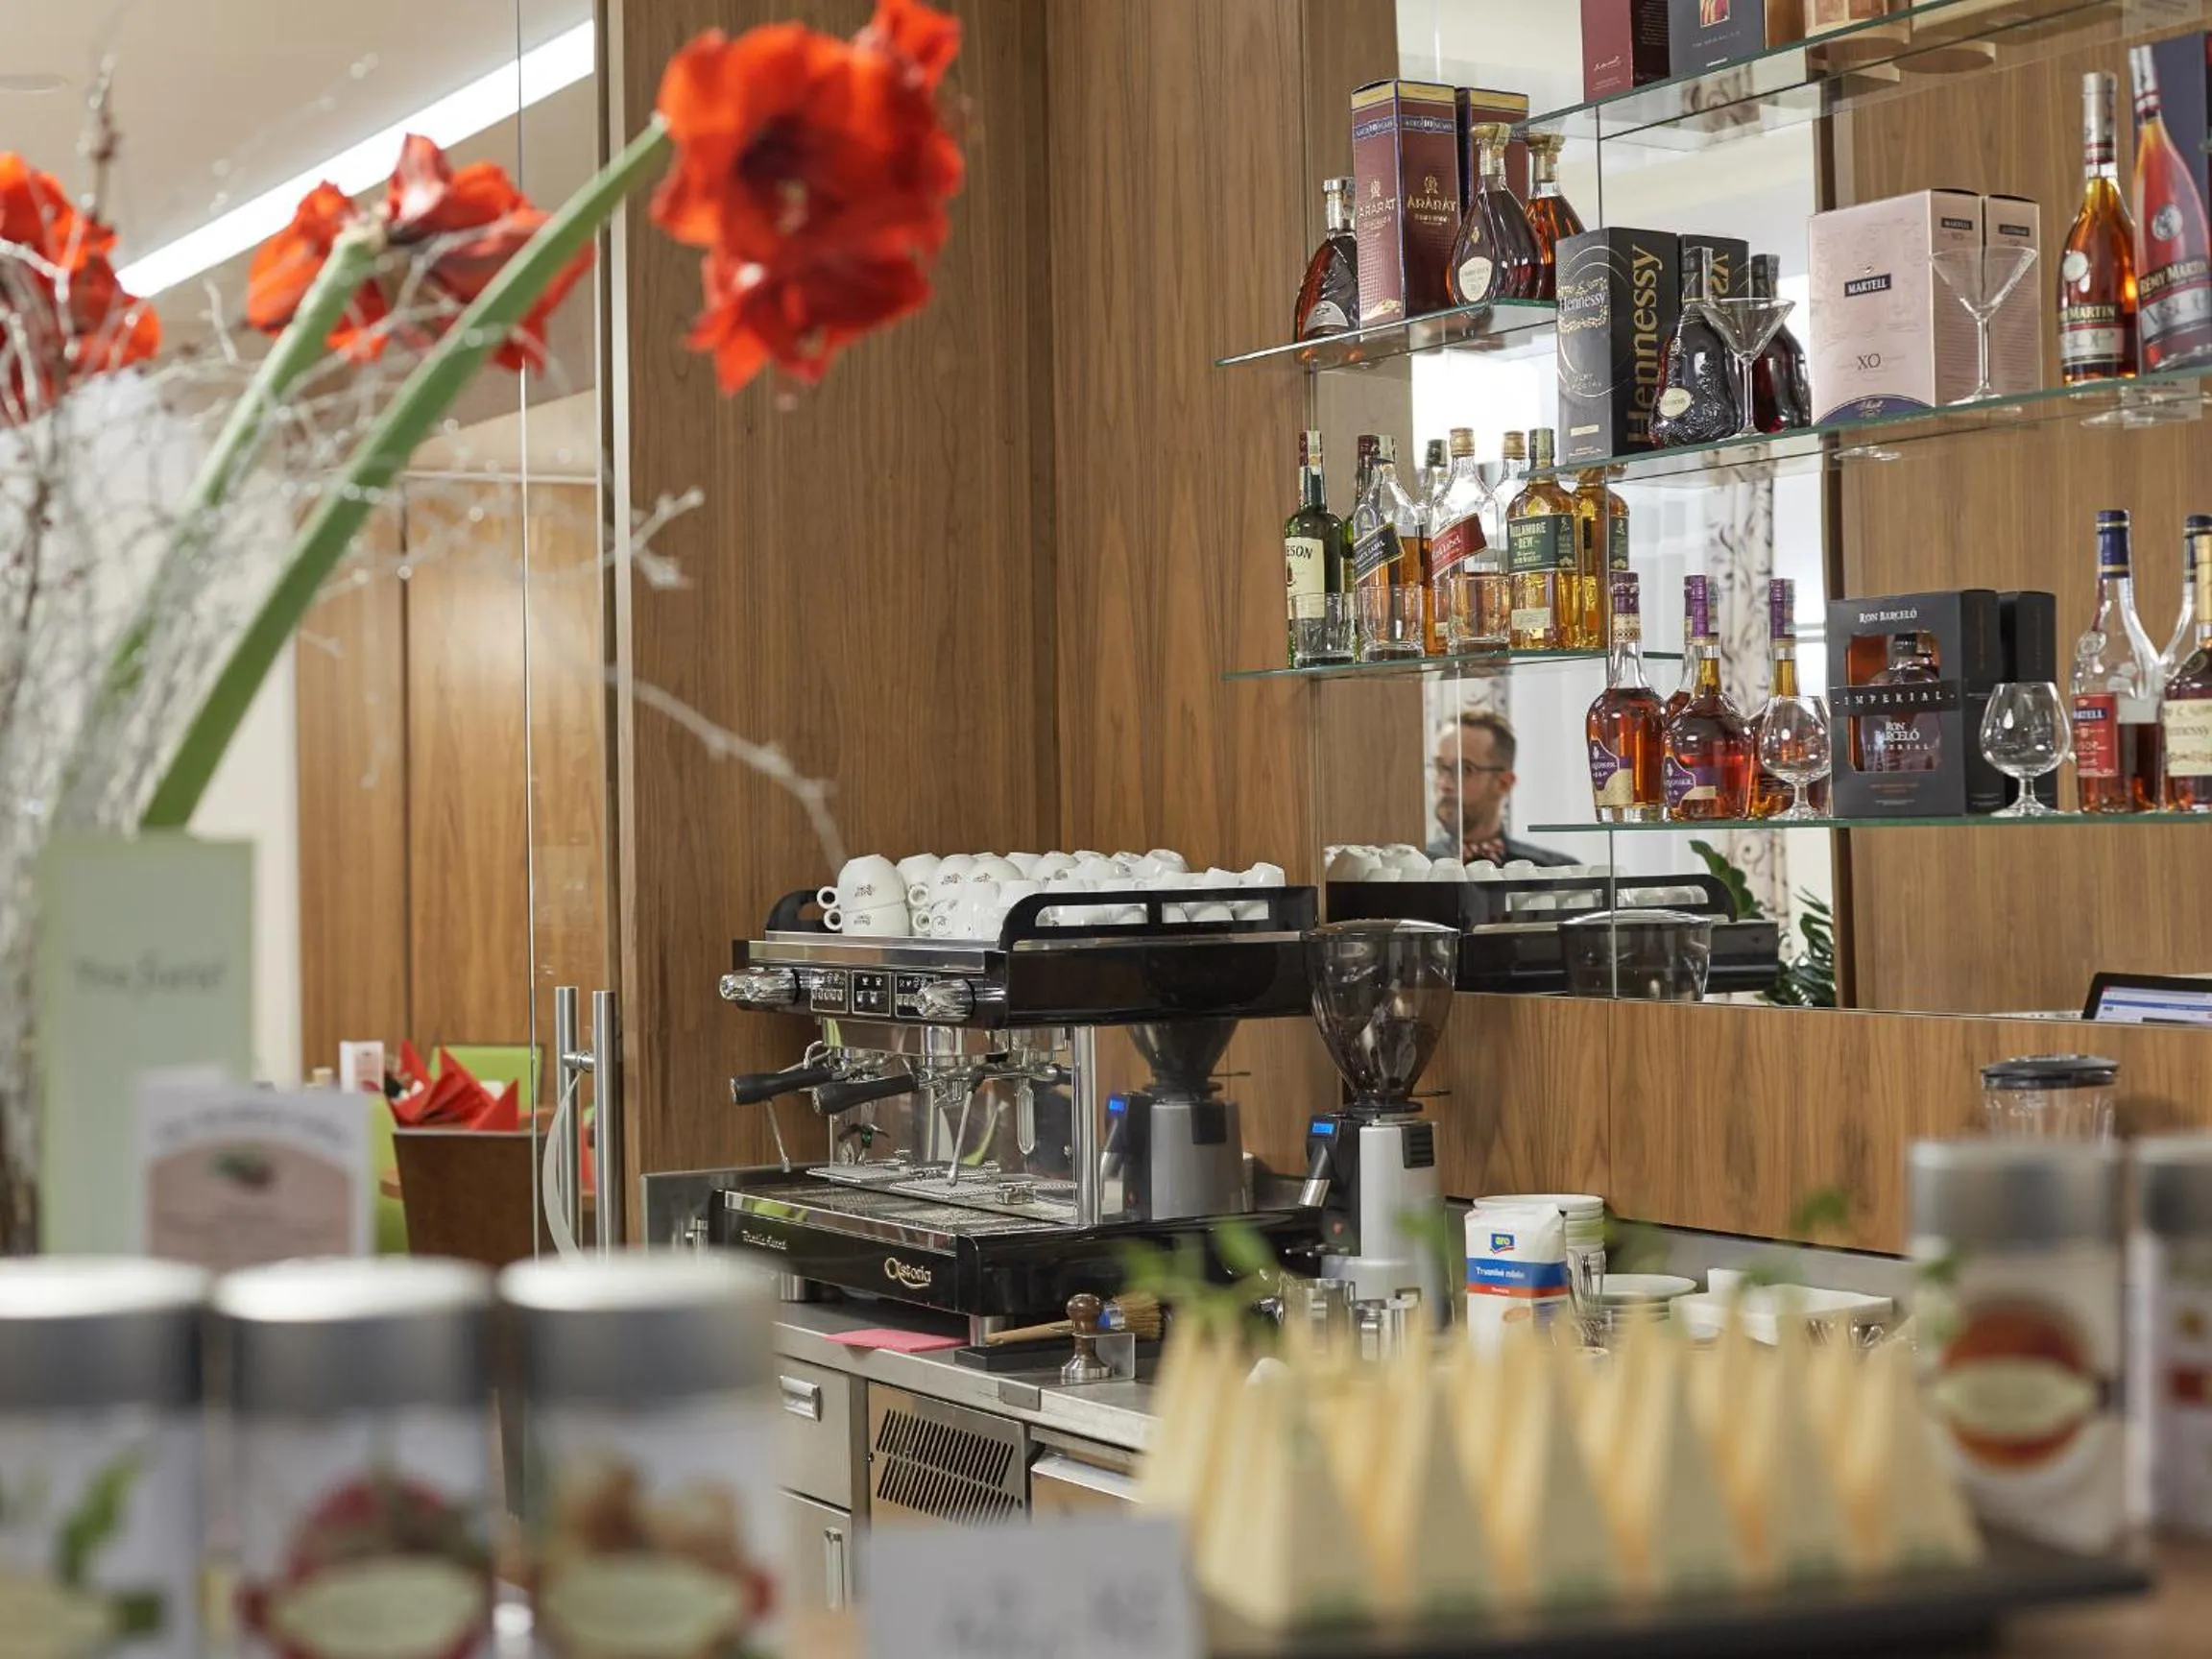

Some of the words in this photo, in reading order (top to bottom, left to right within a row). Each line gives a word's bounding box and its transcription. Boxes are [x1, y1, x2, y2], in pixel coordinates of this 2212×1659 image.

[1359, 198, 1396, 217] ARARAT
[1406, 193, 1456, 212] ARARAT
[1847, 276, 1887, 295] MARTELL
[1559, 291, 1607, 313] Hennessy
[2068, 305, 2116, 319] MARTIN
[1627, 243, 1664, 443] Hennessy
[1857, 352, 1882, 371] XO
[1286, 544, 1313, 560] ESON
[1859, 613, 1878, 623] RON
[1843, 690, 1943, 706] IMPERIAL
[1885, 721, 1907, 732] RON
